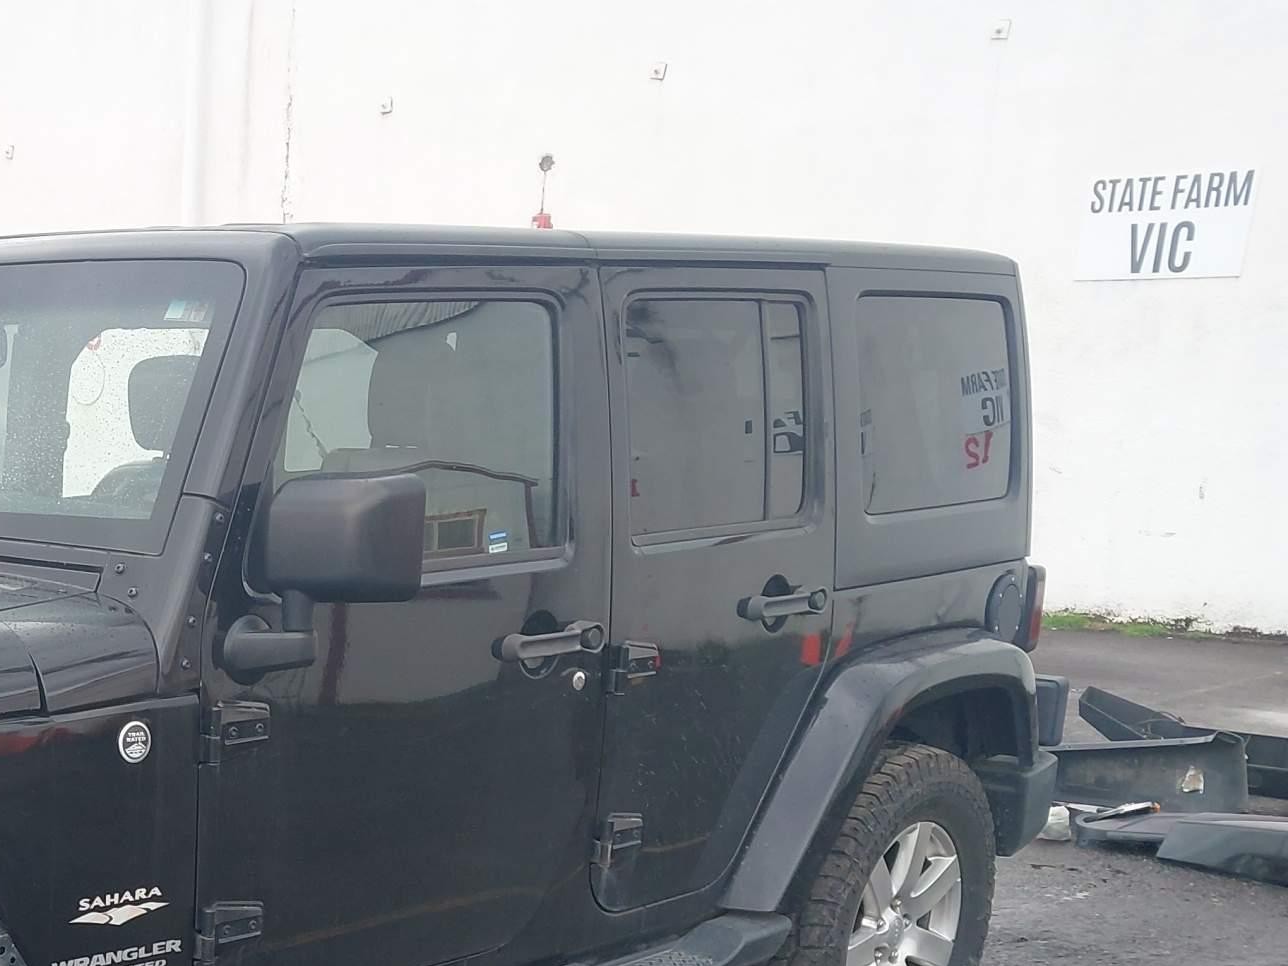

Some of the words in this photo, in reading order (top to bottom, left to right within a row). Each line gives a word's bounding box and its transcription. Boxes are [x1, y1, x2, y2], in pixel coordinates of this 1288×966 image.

[1090, 176, 1166, 214] STATE
[1170, 169, 1255, 210] FARM
[1130, 220, 1196, 274] VIC
[78, 886, 162, 911] SAHARA
